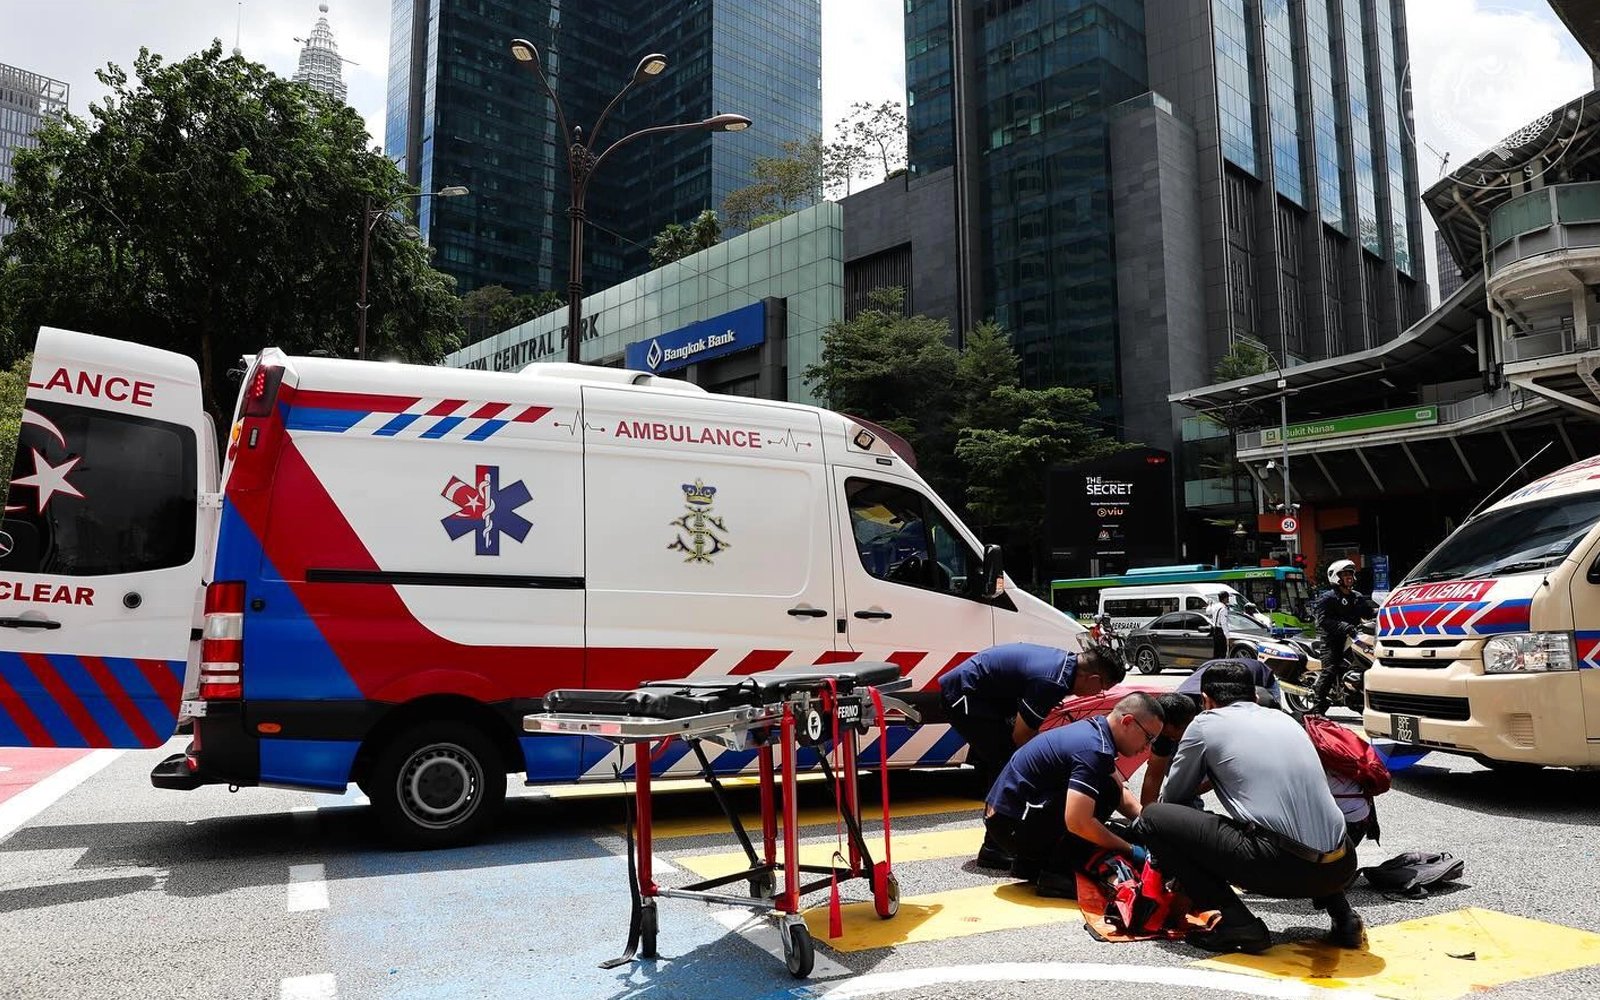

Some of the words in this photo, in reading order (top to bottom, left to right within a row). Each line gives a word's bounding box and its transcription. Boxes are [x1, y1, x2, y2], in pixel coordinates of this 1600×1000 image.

[494, 332, 554, 372] CENTRAL
[561, 313, 600, 349] PRK
[664, 338, 706, 362] Bangkok
[708, 329, 735, 348] Bank
[614, 420, 763, 448] AMBULANCE
[1307, 424, 1335, 435] Nanas
[1086, 484, 1133, 495] SECRET
[1284, 521, 1295, 529] 50
[837, 705, 859, 719] FERNO
[1397, 716, 1410, 729] BPF
[1396, 728, 1413, 742] 7022
